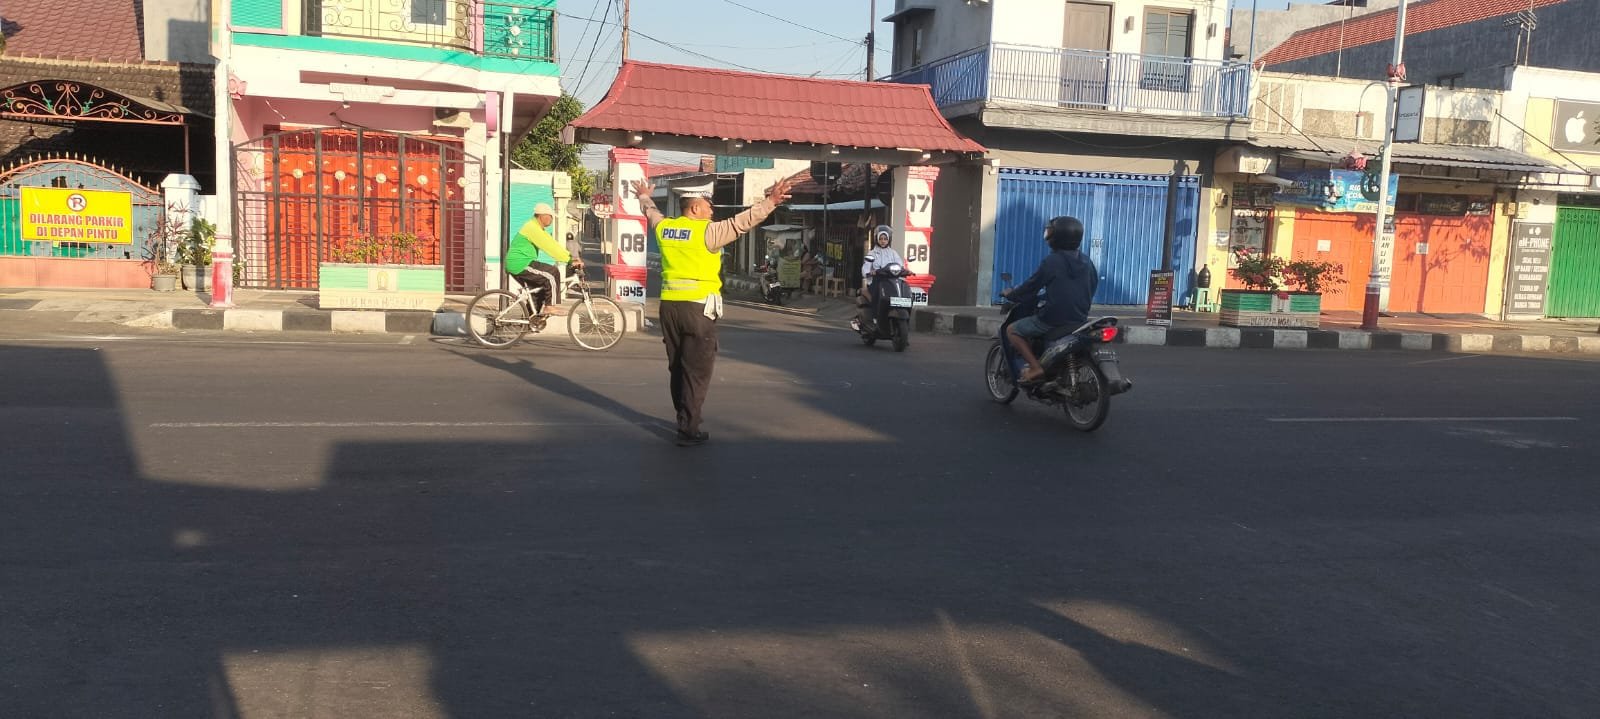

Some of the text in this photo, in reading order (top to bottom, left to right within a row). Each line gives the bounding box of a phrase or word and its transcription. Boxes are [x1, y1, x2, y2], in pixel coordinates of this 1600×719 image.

[909, 194, 931, 213] 17
[30, 214, 123, 227] DILARANG PARKIR
[37, 227, 117, 239] DI DEPAN PINTU
[663, 228, 692, 241] POLISI
[621, 233, 645, 253] 08
[907, 244, 928, 262] 08
[619, 286, 644, 297] 1945
